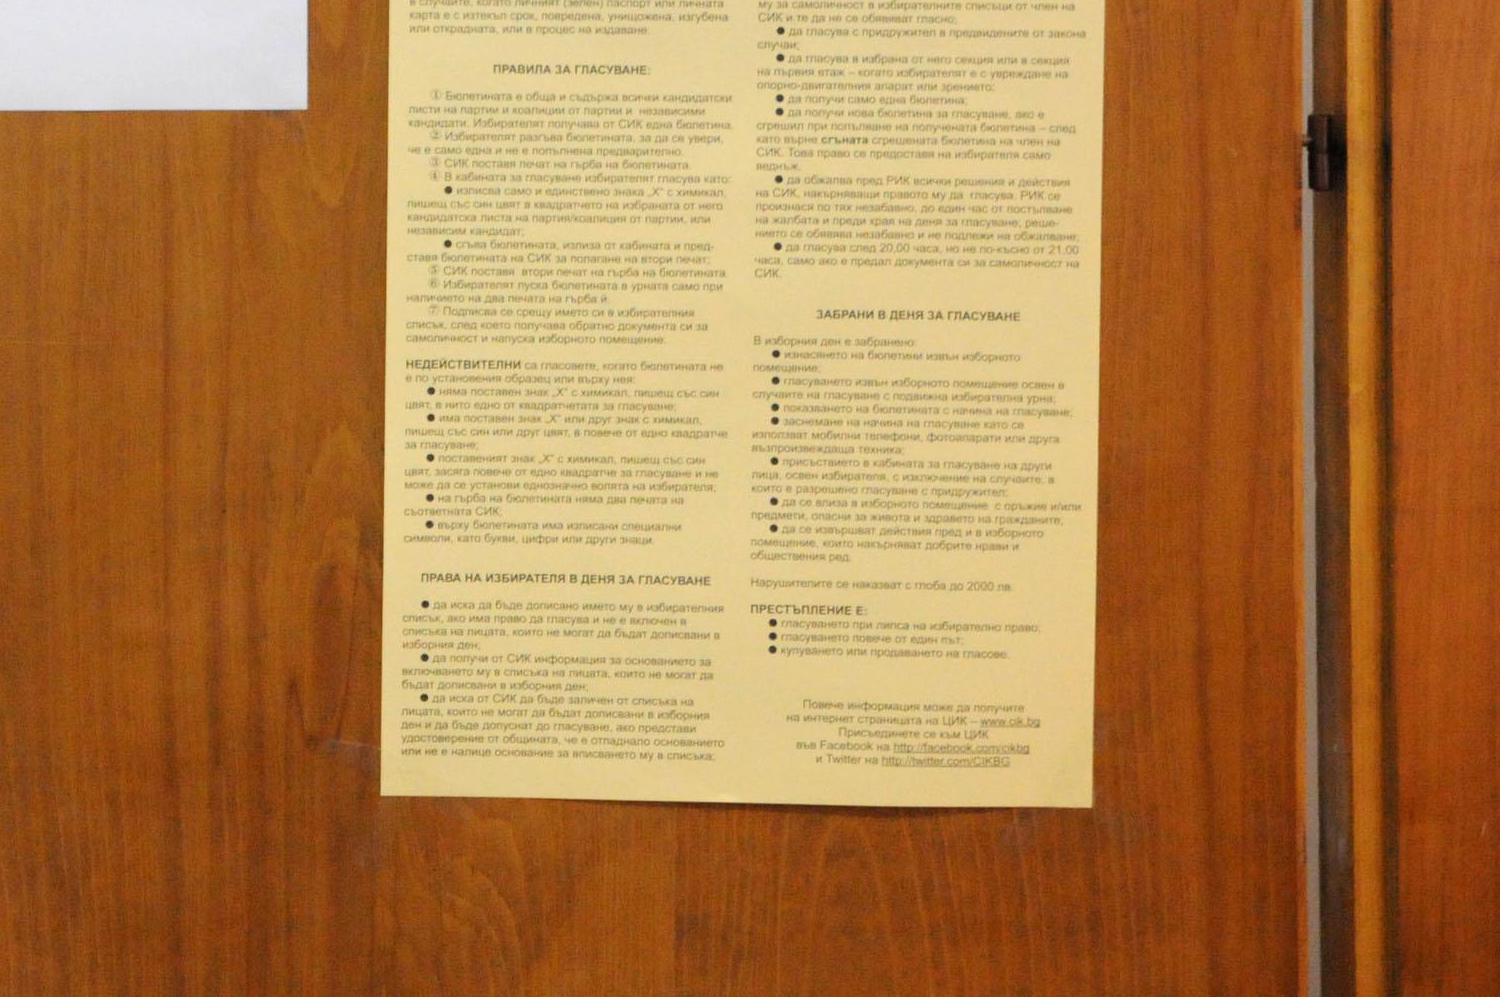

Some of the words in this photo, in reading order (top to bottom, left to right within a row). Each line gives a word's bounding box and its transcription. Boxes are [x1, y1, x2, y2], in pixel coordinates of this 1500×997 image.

[492, 63, 551, 74] ПРАВИЛА
[555, 64, 571, 74] ЗА
[755, 135, 781, 144] като
[783, 136, 818, 146] върне
[820, 136, 869, 145] сгъната
[871, 136, 938, 147] сгрешената
[940, 135, 996, 146] бюлетина
[999, 137, 1013, 146] на
[1015, 138, 1044, 146] член
[1046, 138, 1061, 147] на
[816, 308, 874, 320] ЗАБРАНИ
[877, 309, 886, 320] В
[888, 309, 924, 321] ДЕНЯ
[927, 310, 944, 321] ЗА
[946, 310, 1020, 322] ГЛАСУВАНЕ
[752, 335, 762, 345] В
[764, 335, 818, 348] изборния
[819, 338, 841, 348] ден
[843, 338, 852, 346] е
[405, 357, 521, 370] НЕДЕЙСТВИТЕЛНИ
[524, 361, 537, 369] са
[602, 362, 637, 371] когато
[639, 360, 706, 371] бюлетината
[709, 363, 724, 372] не
[403, 507, 472, 516] съответната
[420, 571, 462, 583] ПРАВА
[464, 572, 482, 583] НА
[484, 572, 566, 584] ИЗБИРАТЕЛЯ
[568, 573, 578, 584] В
[580, 573, 615, 585] ДЕНЯ
[618, 574, 635, 585] ЗА
[637, 574, 711, 586] ГЛАСУВАНЕ
[749, 576, 833, 590] Нарушителите
[835, 580, 850, 588] се
[851, 580, 902, 589] наказват
[904, 581, 911, 590] с
[914, 579, 947, 590] глоба
[948, 582, 964, 592] до
[966, 580, 995, 591] 2000
[750, 602, 852, 614] ПРЕСТЪПЛЕНИЕ
[780, 619, 850, 631] гласуването
[851, 621, 873, 631] при
[875, 621, 910, 630] липса
[912, 622, 927, 630] на
[928, 620, 1002, 634] избирателно
[401, 638, 454, 651] изборния
[780, 633, 850, 644] гласуването
[851, 634, 892, 643] повече
[894, 635, 907, 643] от
[909, 635, 938, 646] един
[780, 646, 844, 658] купуването
[845, 647, 868, 656] или
[869, 648, 943, 659] продаването
[945, 649, 960, 658] на
[802, 698, 844, 710] Повече
[846, 700, 920, 714] информация
[922, 703, 954, 712] може
[955, 704, 971, 714] да
[972, 704, 1025, 715] получите
[785, 714, 800, 722] на
[802, 714, 854, 725] интернет
[856, 715, 923, 727] страницата
[924, 717, 939, 725] на
[941, 715, 967, 728] ЦИК
[979, 716, 1041, 729] www.cik.bg
[838, 726, 920, 740] Присъединете
[922, 730, 937, 739] се
[939, 730, 961, 739] към
[963, 729, 989, 741] ЦИК
[795, 740, 817, 749] във
[819, 739, 873, 750] Facebook
[876, 743, 890, 751] на
[892, 740, 1030, 754] http://facebook.com/cikbg
[815, 754, 823, 762] и
[825, 752, 862, 763] Twitter
[863, 756, 879, 764] на
[880, 754, 1011, 767] http://twitter.com/CIKBG
